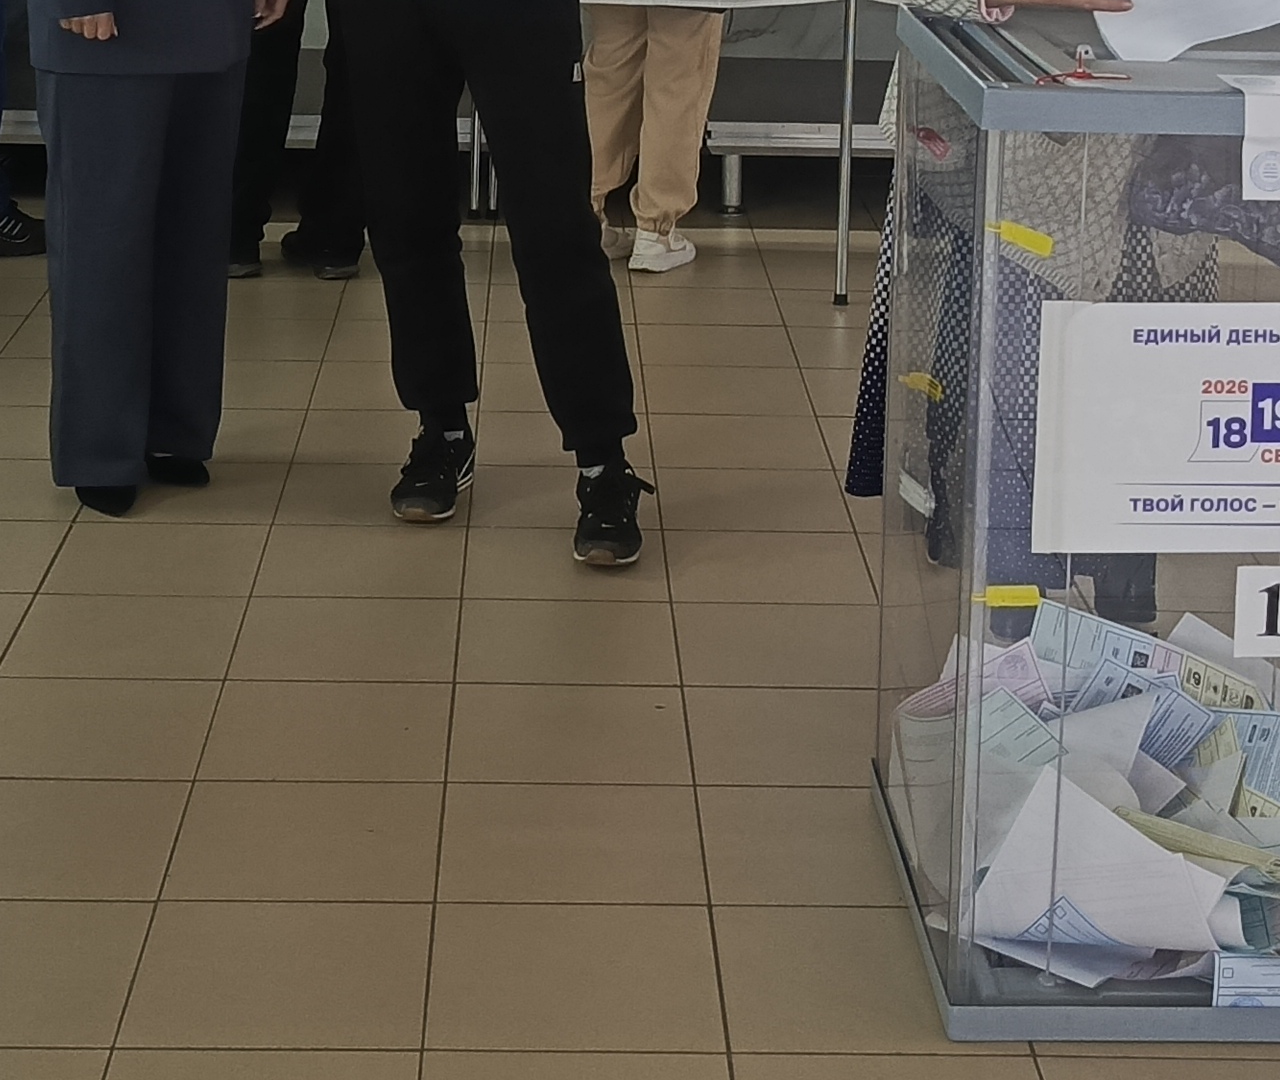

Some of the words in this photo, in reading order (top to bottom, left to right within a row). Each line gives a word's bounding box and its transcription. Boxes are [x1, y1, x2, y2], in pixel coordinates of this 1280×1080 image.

[1132, 325, 1221, 345] ЕДИНЫЙ
[1225, 328, 1280, 347] ДЕНЬ
[1201, 379, 1248, 395] 2026
[1206, 417, 1248, 449] 18
[1129, 494, 1184, 513] ТВОЙ
[1189, 497, 1258, 513] ГОЛОС
